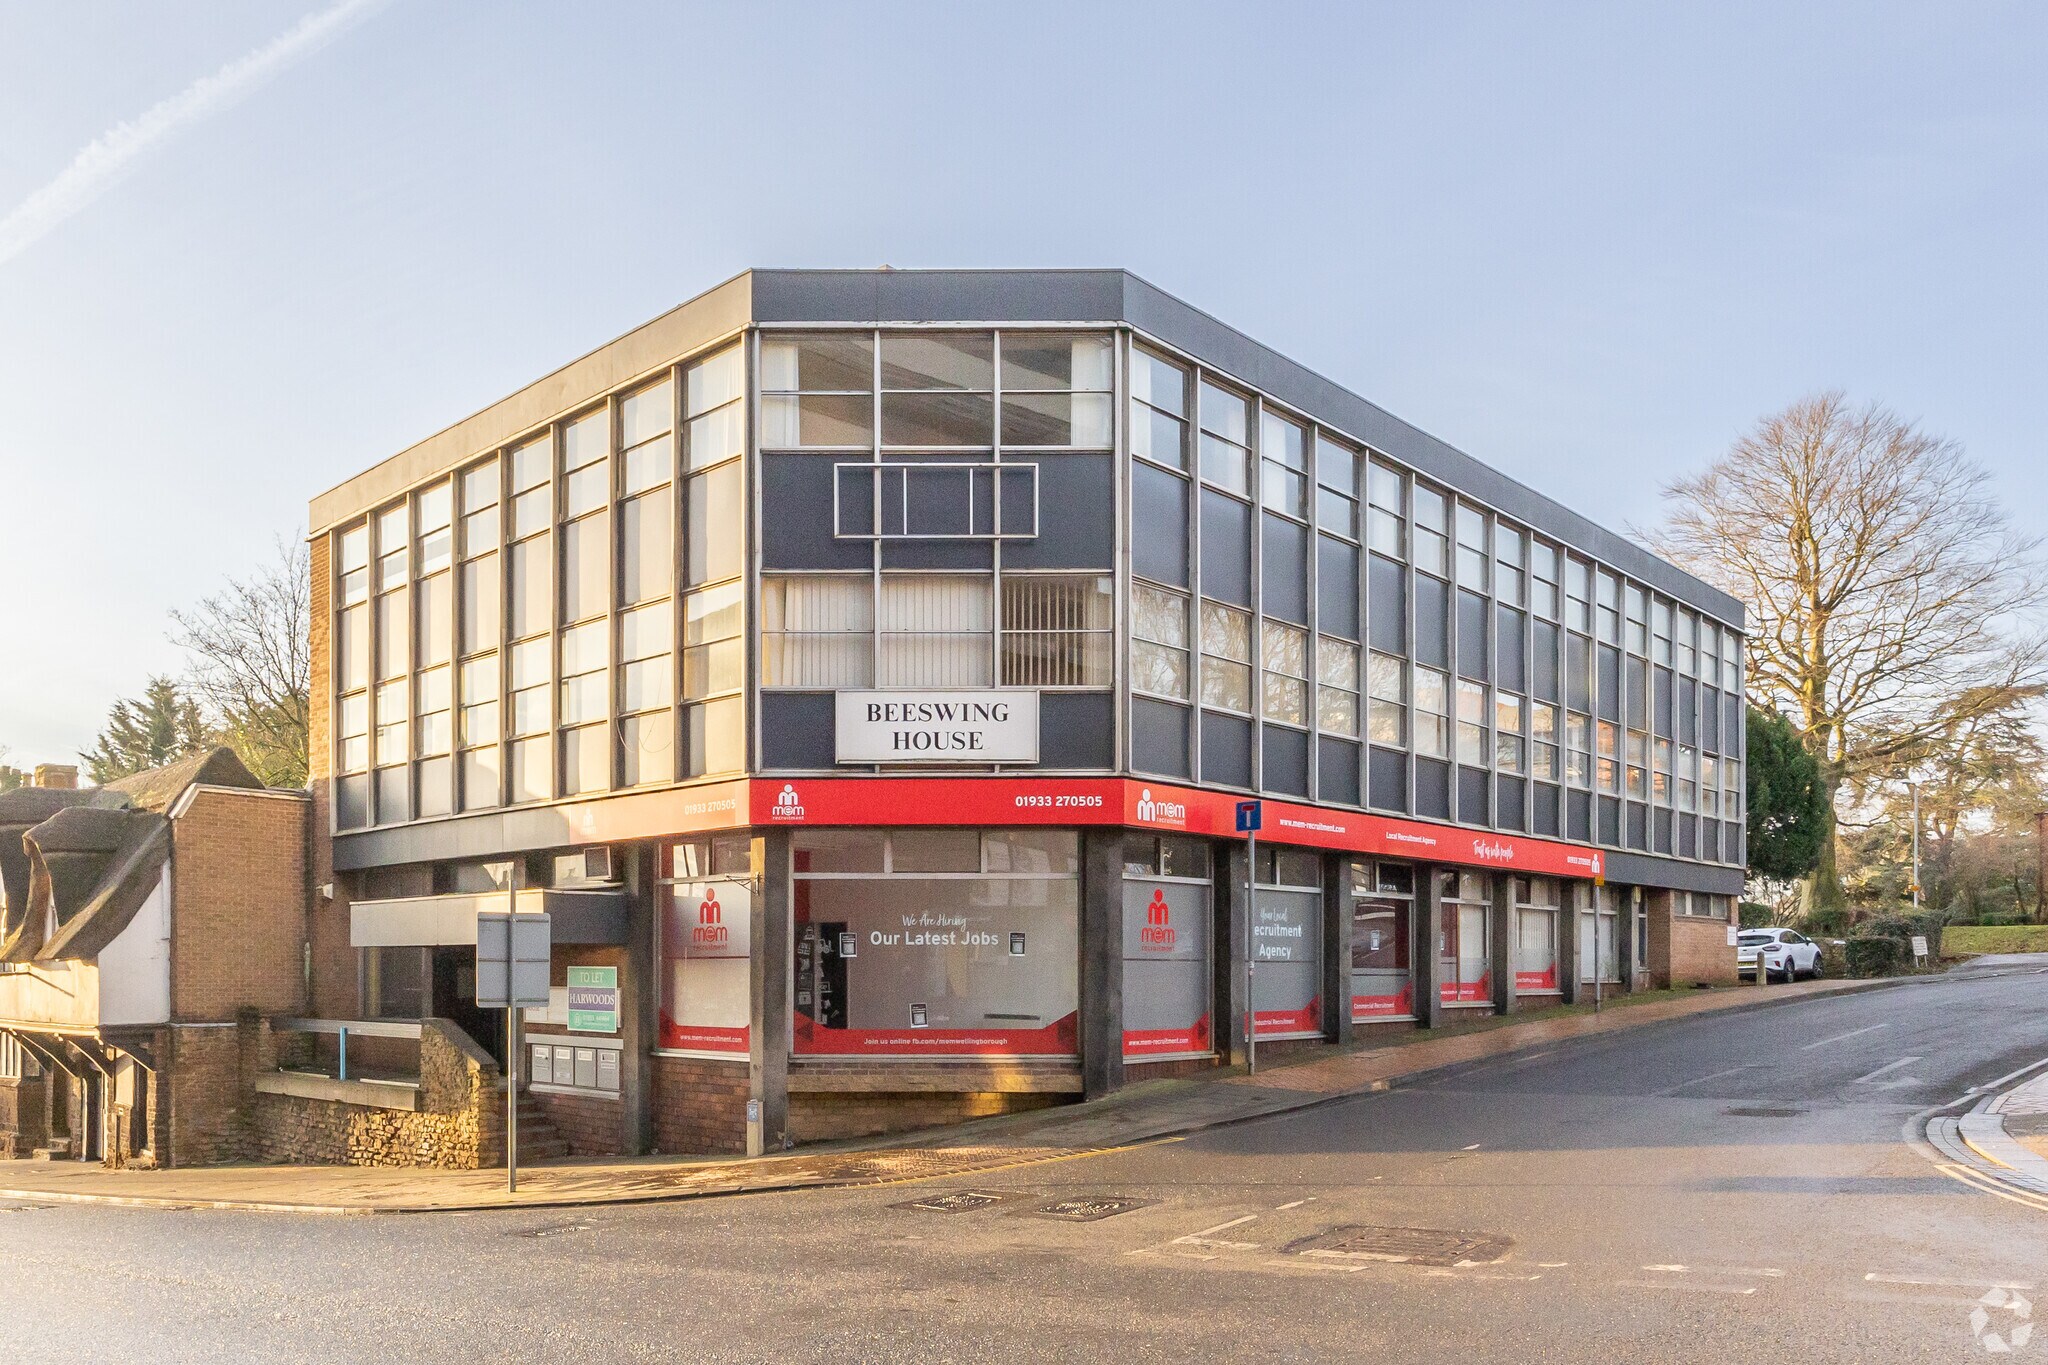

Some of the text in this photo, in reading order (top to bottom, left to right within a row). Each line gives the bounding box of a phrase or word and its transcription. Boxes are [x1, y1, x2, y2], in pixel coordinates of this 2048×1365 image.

[866, 703, 1009, 722] BEESWING
[893, 731, 984, 750] HOUSE
[684, 799, 736, 815] 01933 270505
[1015, 796, 1103, 807] 01933 270505
[772, 805, 804, 816] mem
[1156, 802, 1185, 818] mem
[902, 913, 968, 932] We Are Hiring
[1254, 924, 1302, 937] ecruitment
[693, 926, 727, 942] mem
[870, 931, 900, 945] Our
[905, 931, 956, 946] Latest
[961, 931, 999, 946] Jobs
[1141, 927, 1175, 943] mem
[1259, 943, 1291, 960] Agency
[580, 972, 604, 983] TO LET
[569, 993, 615, 1006] HARWOODS
